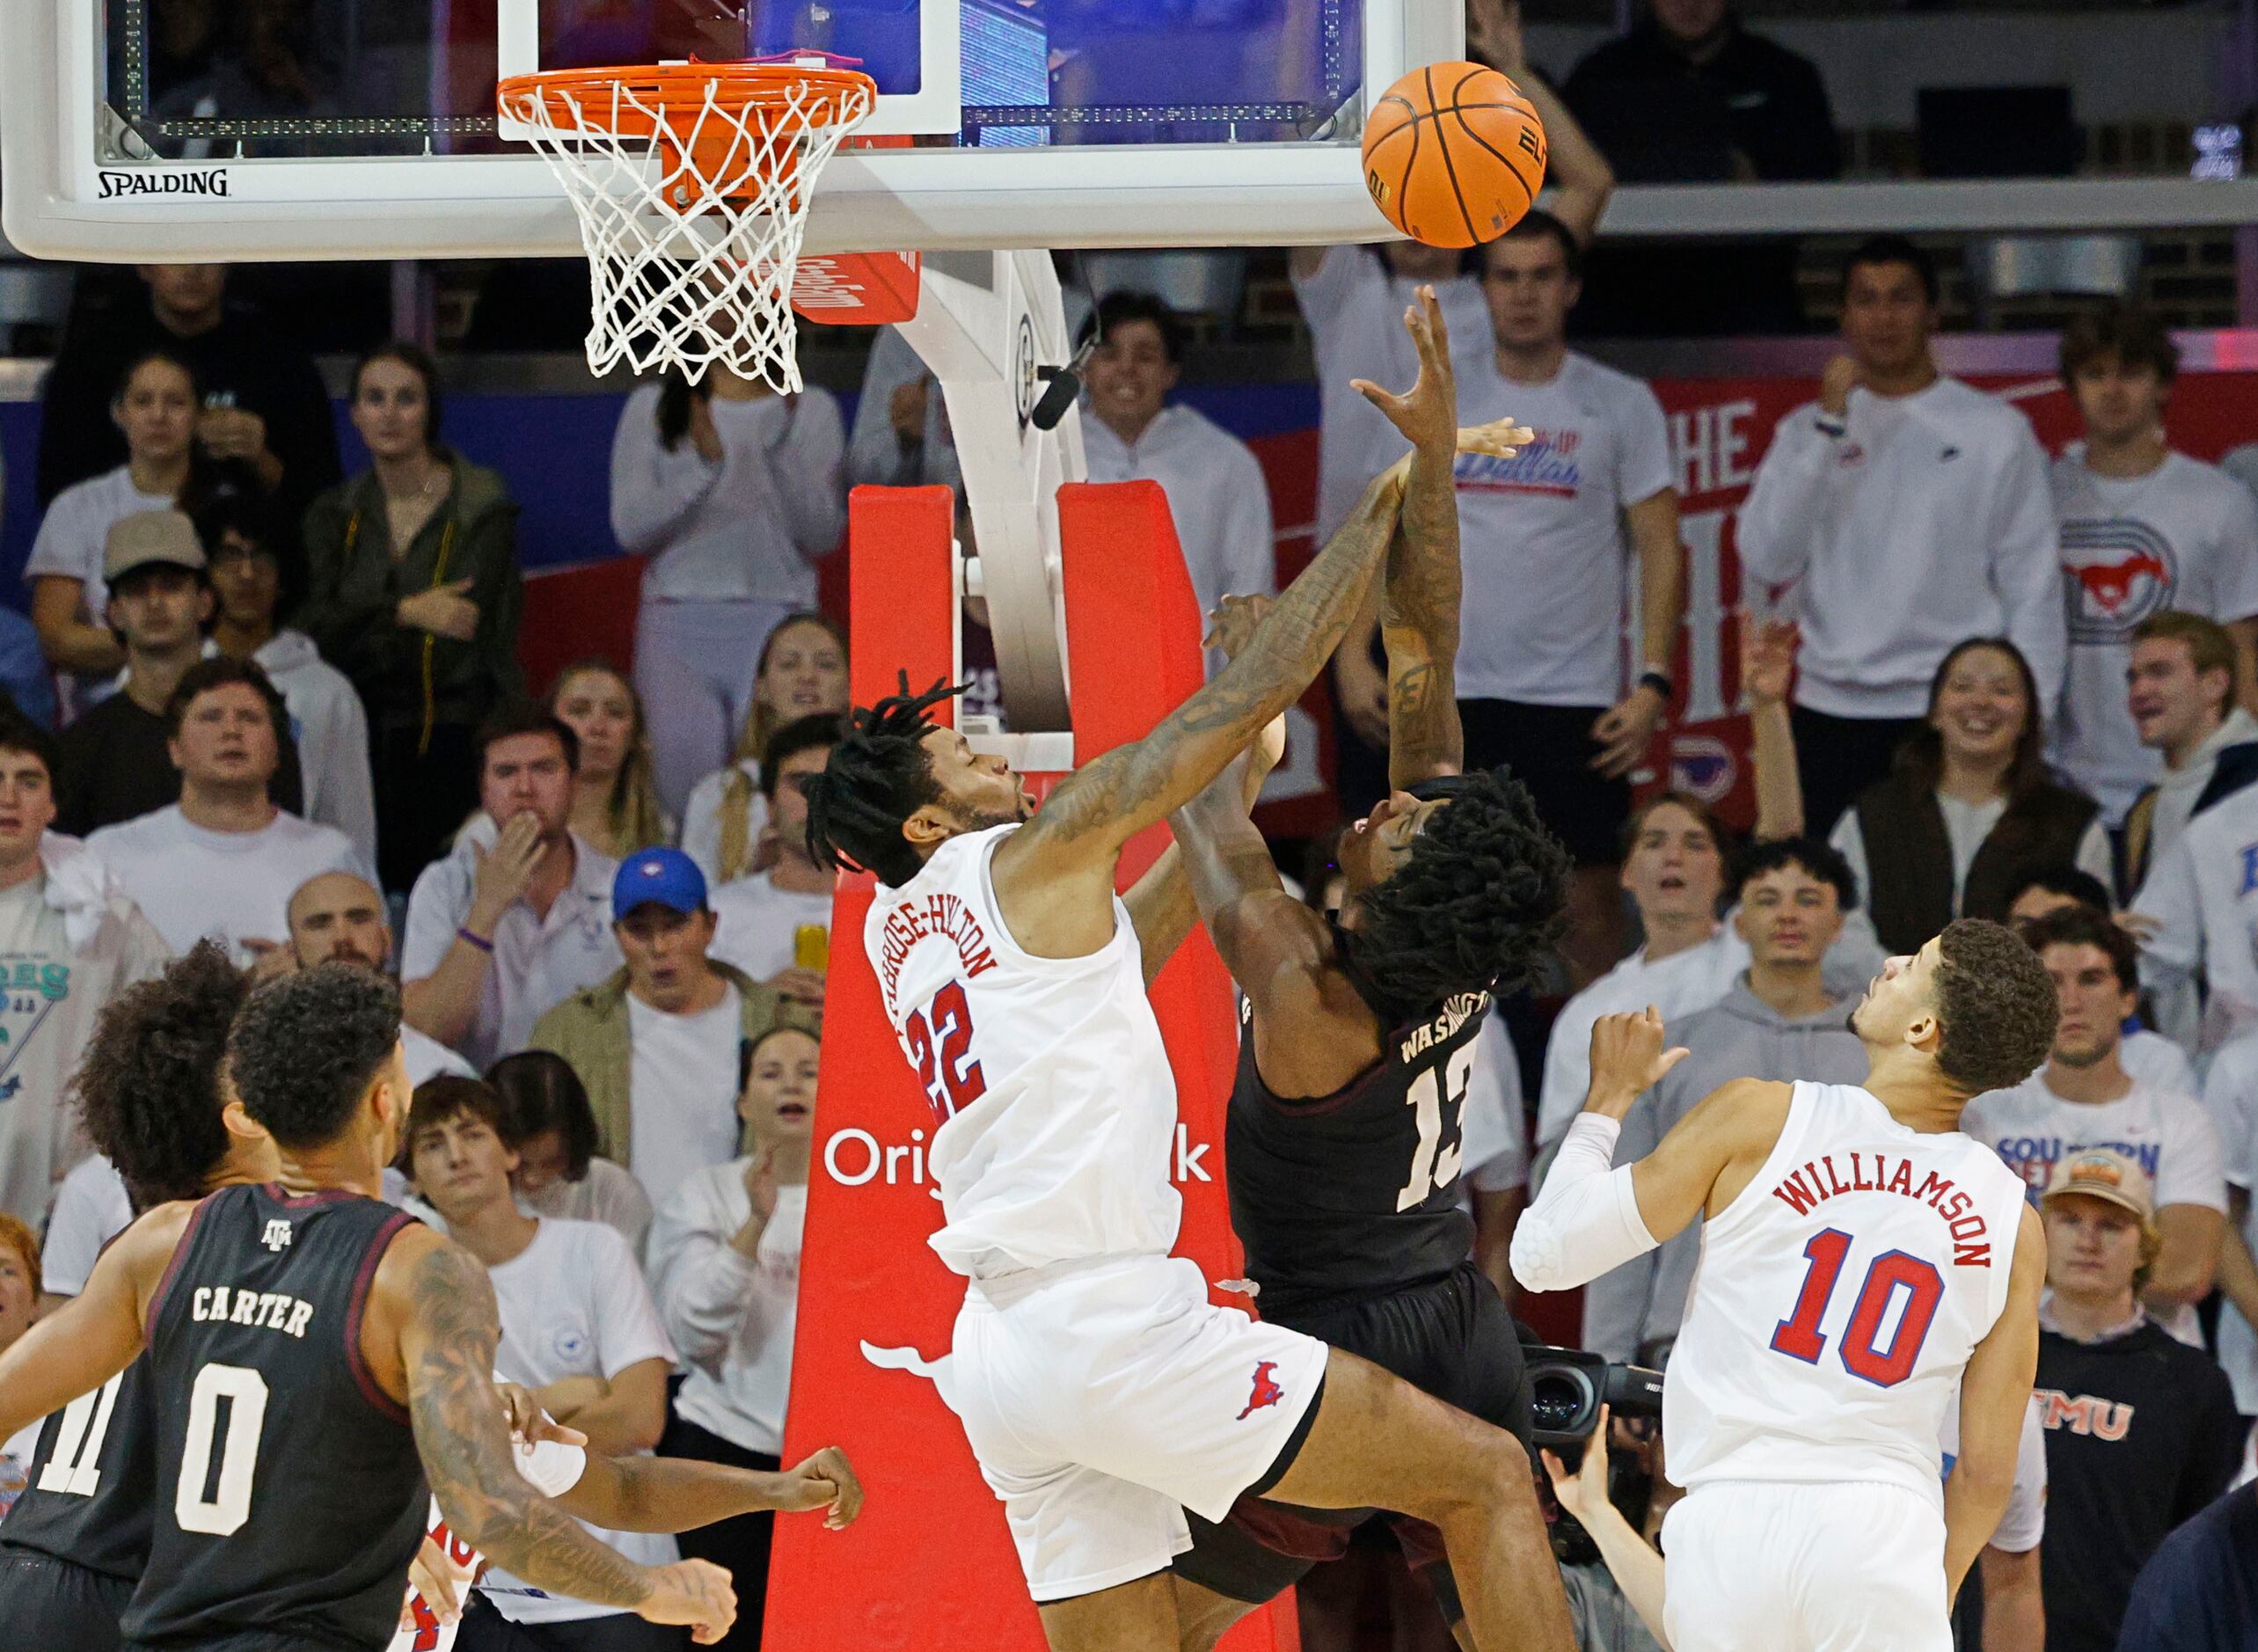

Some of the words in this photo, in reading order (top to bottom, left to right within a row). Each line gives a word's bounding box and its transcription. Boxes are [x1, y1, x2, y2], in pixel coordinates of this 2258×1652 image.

[99, 169, 227, 199] SPALDING
[1670, 402, 1756, 498] HE
[906, 978, 987, 1127] 22
[1397, 1036, 1477, 1214] 13
[1772, 1152, 1991, 1268] WILLIAMSON
[193, 1286, 313, 1337] CARTER
[1770, 1227, 1945, 1389] 10
[37, 1371, 124, 1496] 11
[175, 1363, 269, 1537] 0
